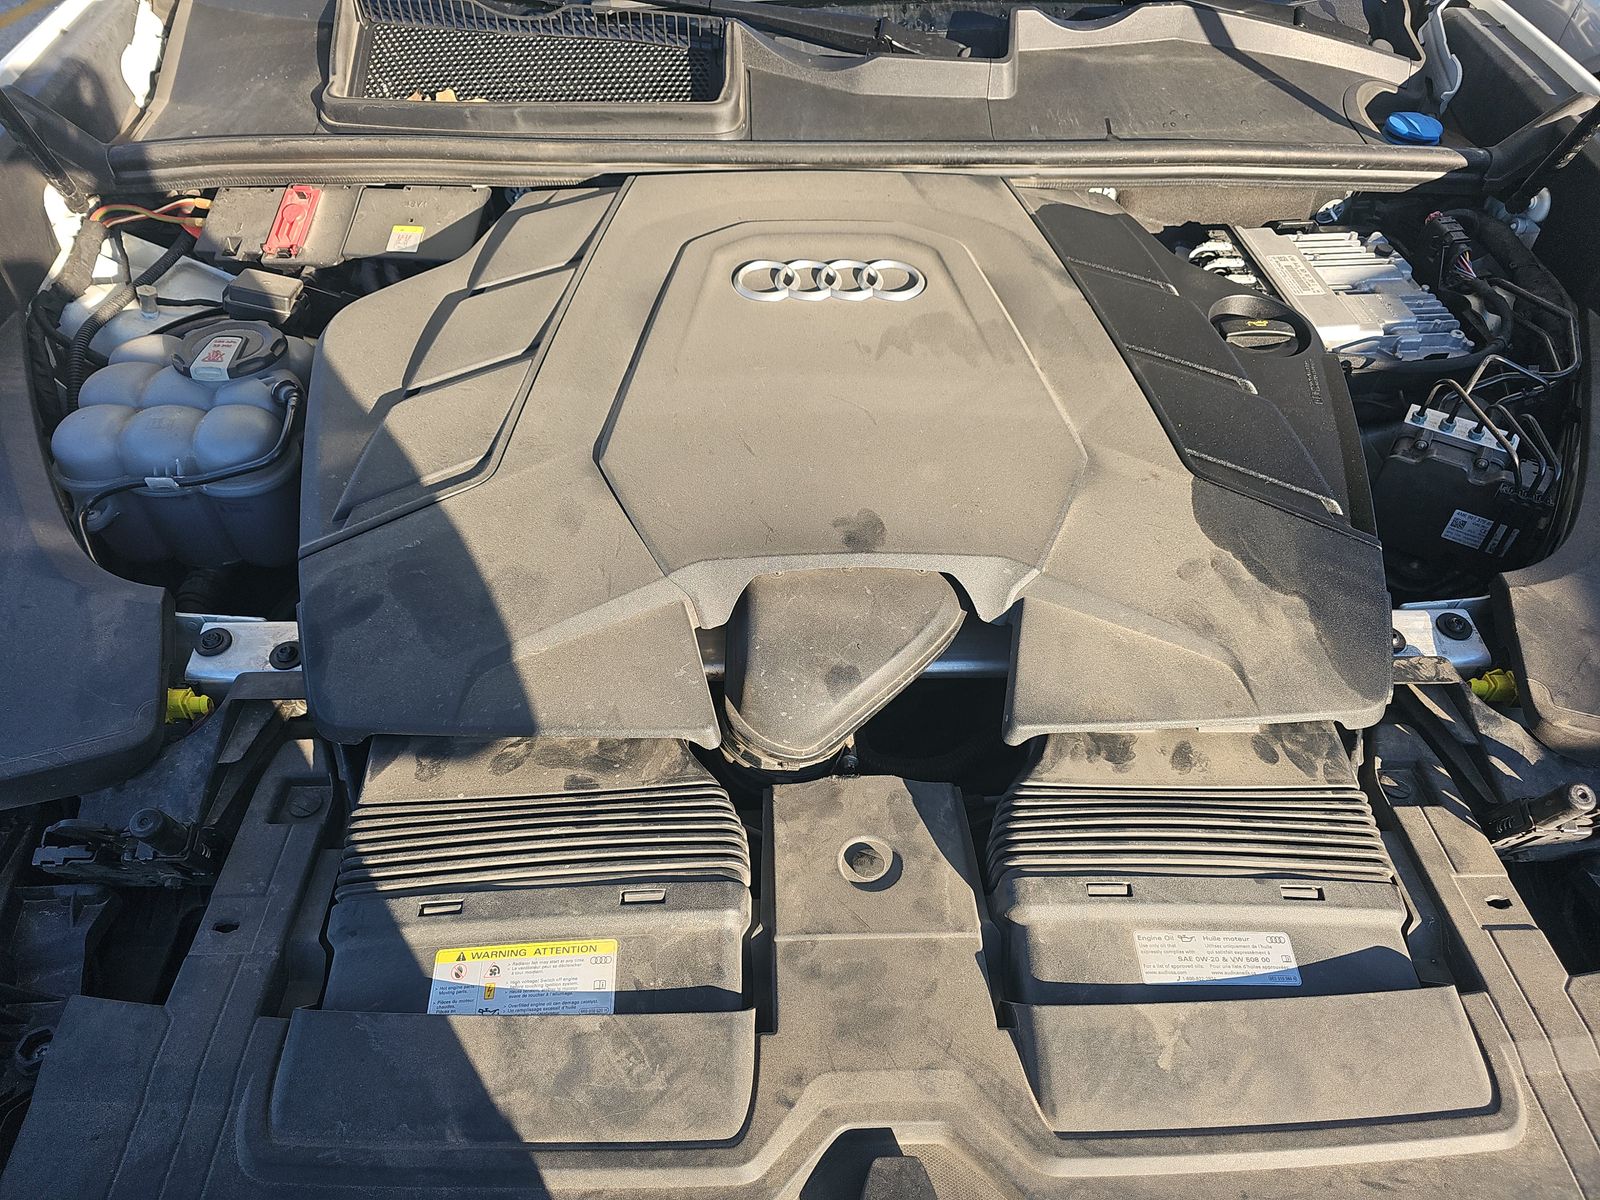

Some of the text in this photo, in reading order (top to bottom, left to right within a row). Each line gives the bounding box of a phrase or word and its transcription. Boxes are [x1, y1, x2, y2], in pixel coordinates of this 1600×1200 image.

[1137, 934, 1162, 942] Engine
[471, 949, 527, 960] WARNING
[533, 945, 597, 955] ATTENTION
